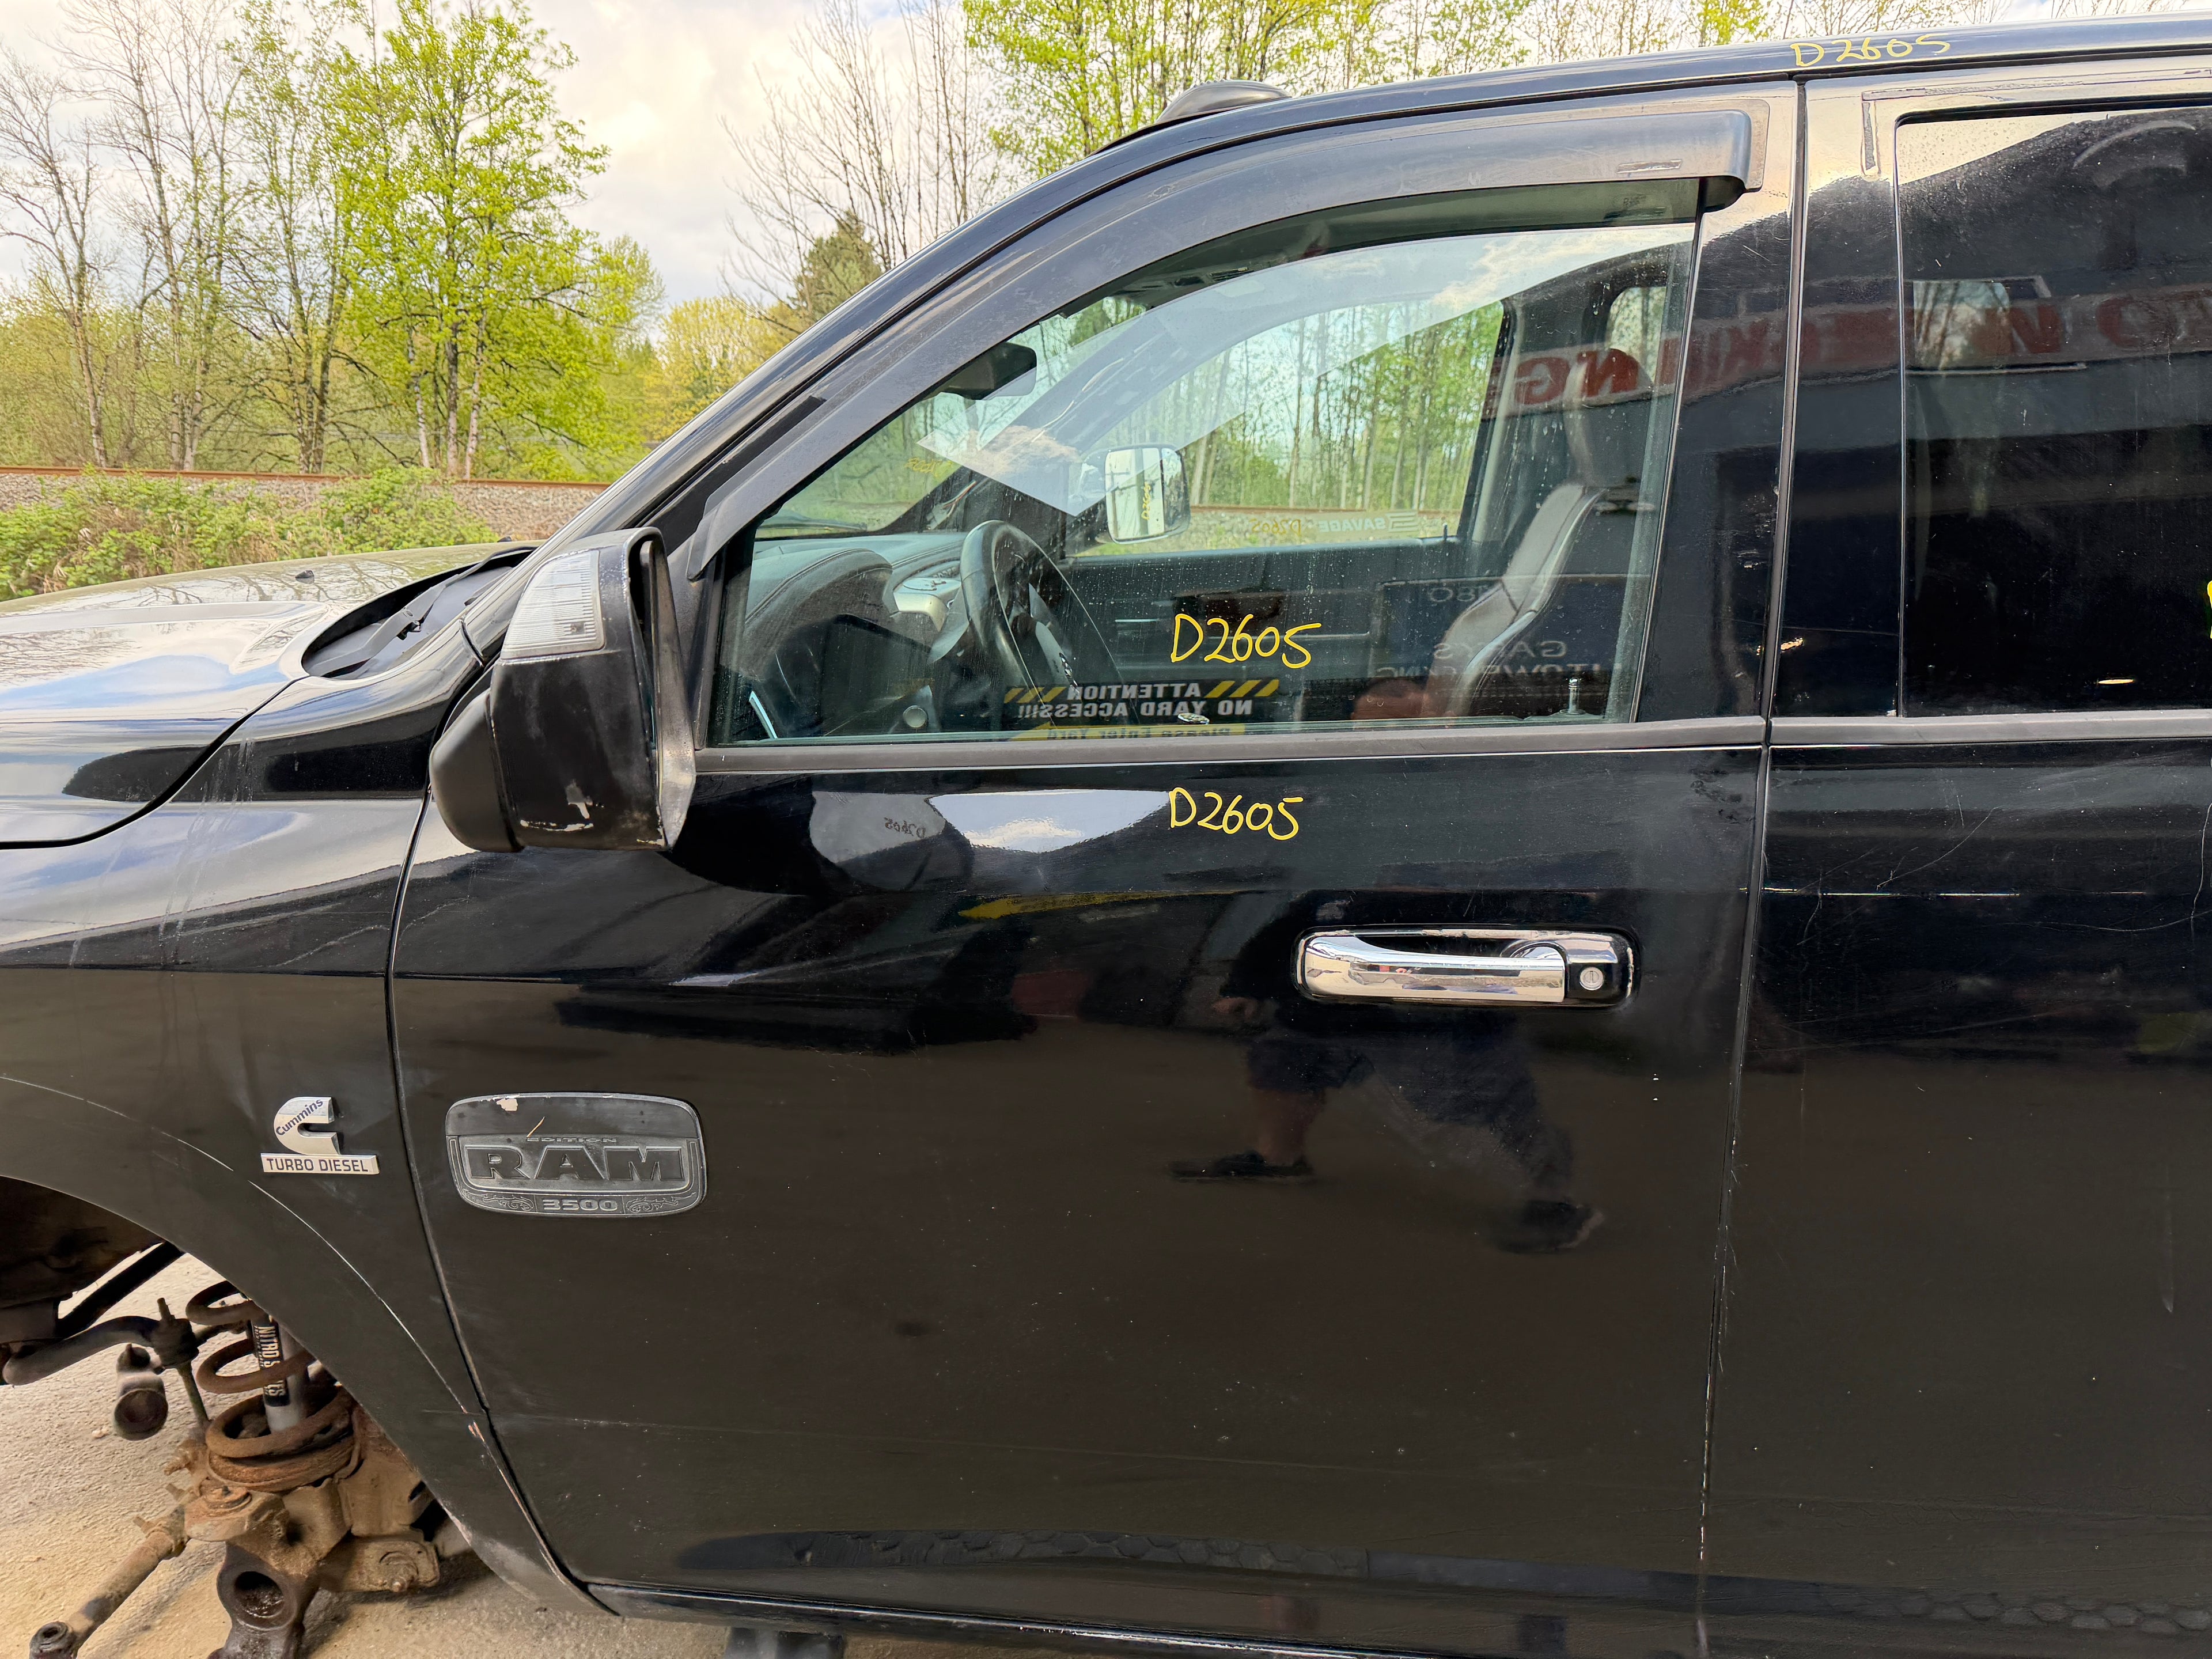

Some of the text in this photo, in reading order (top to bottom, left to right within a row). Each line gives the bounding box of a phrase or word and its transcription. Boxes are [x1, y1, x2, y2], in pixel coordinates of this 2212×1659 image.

[1789, 33, 1951, 67] D2605
[1170, 613, 1322, 669] D2605
[1169, 787, 1304, 840] D2605
[276, 1099, 323, 1135] Cummins
[267, 1158, 368, 1172] TURBO DIESEL
[464, 1145, 685, 1180] RAM
[542, 1198, 618, 1211] 3500
[259, 1326, 280, 1358] NITRO
